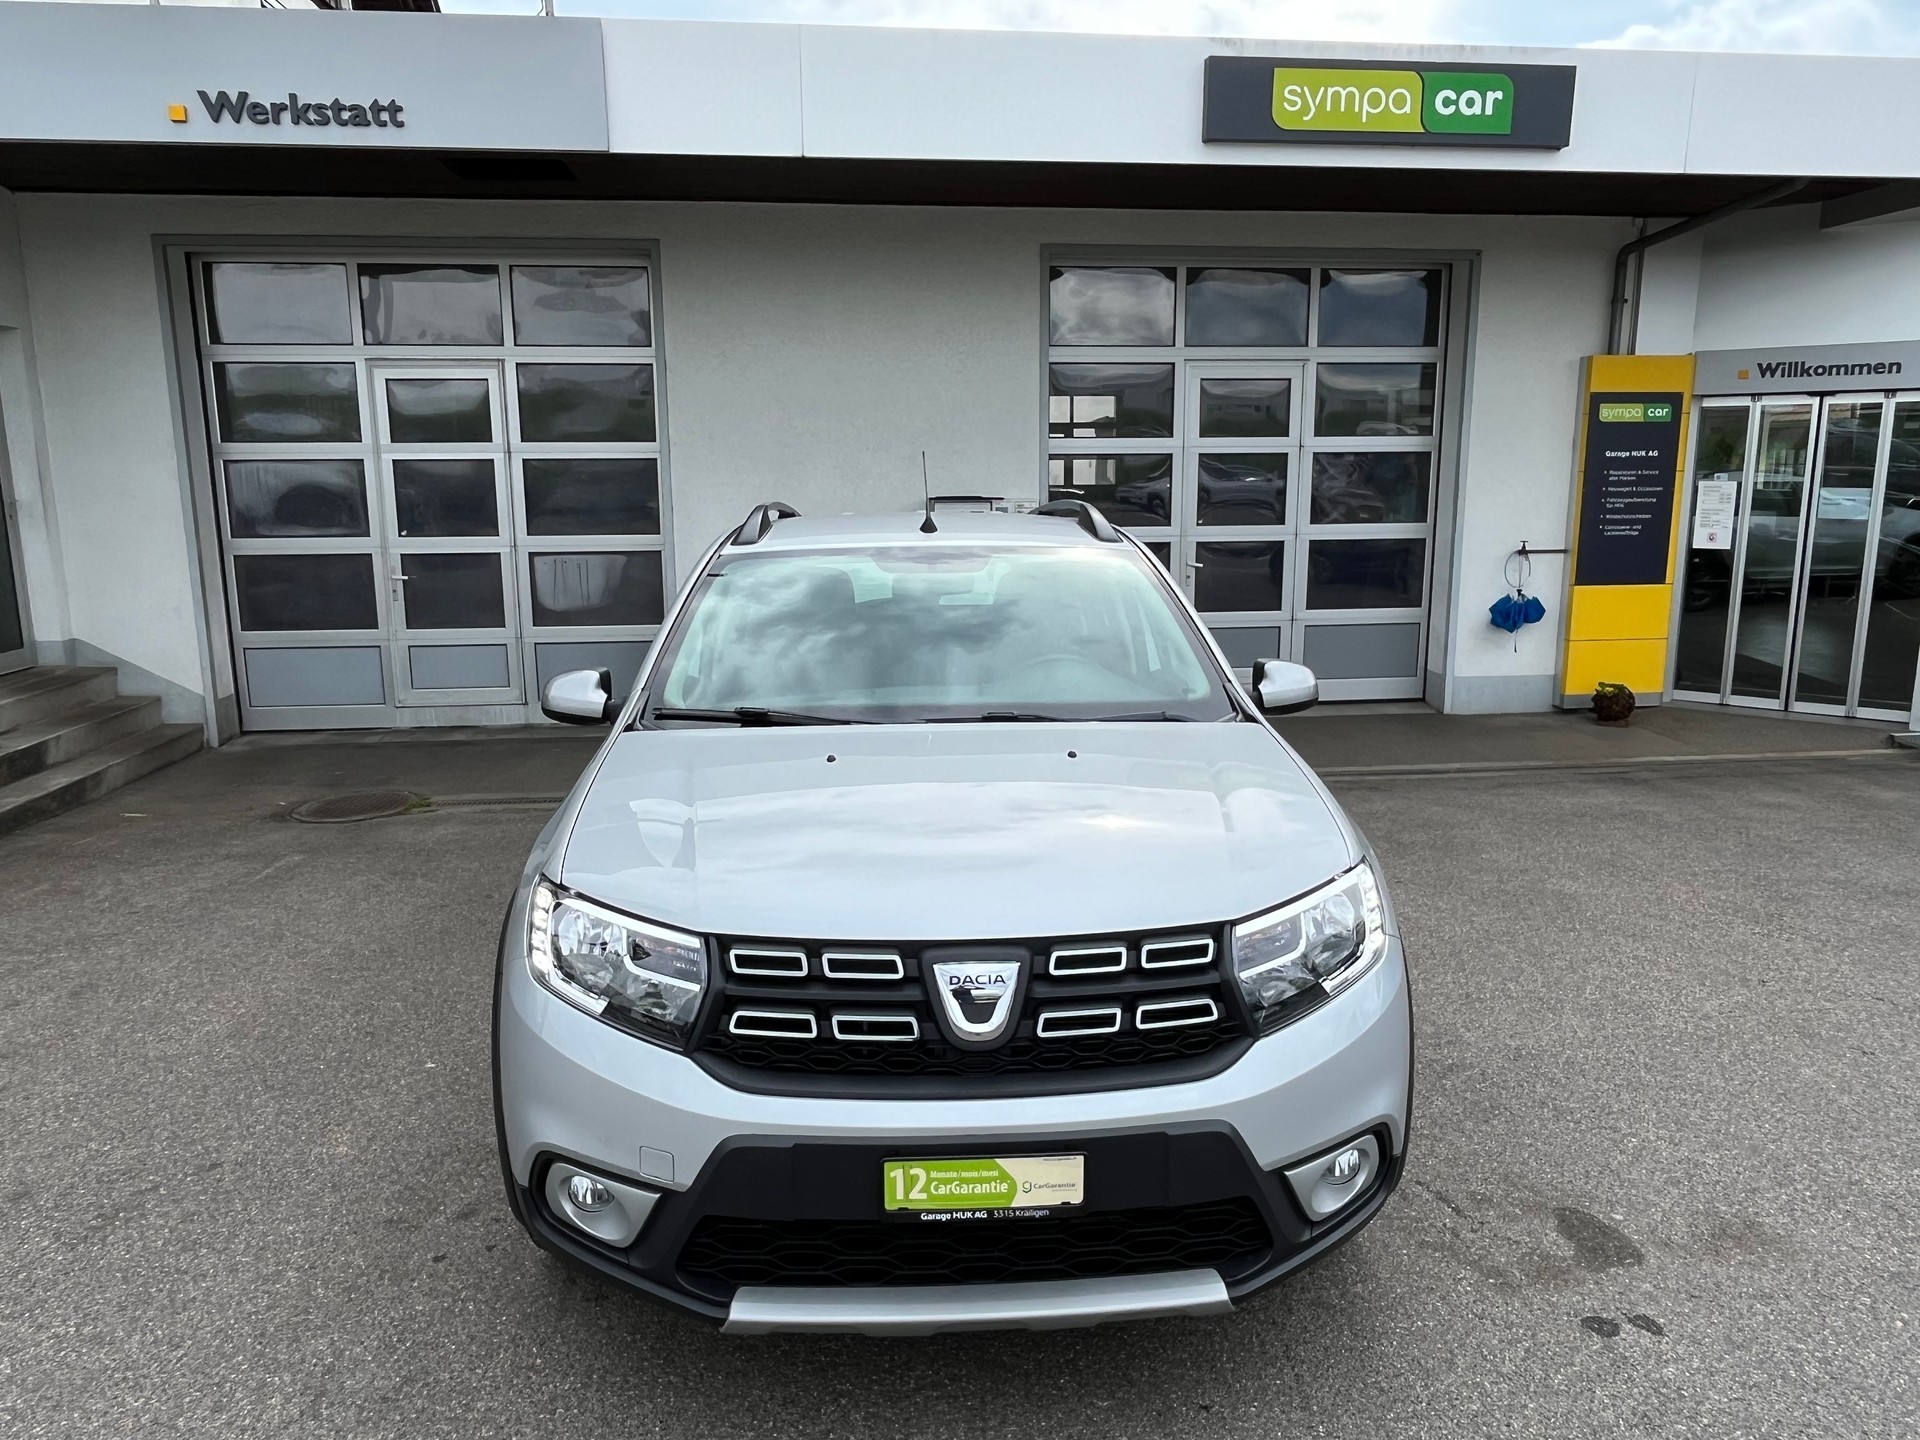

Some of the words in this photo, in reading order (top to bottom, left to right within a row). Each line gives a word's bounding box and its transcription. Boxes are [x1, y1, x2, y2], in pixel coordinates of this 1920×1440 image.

[196, 89, 405, 128] Werkstatt
[1282, 84, 1411, 122] sympa
[1434, 89, 1503, 116] car
[1757, 361, 1902, 379] Willkommen
[1602, 407, 1641, 419] sympa
[1648, 406, 1669, 417] car
[1605, 450, 1630, 458] Garage
[949, 974, 1006, 986] DACIA
[889, 1167, 928, 1200] 12
[930, 1180, 1009, 1195] CarGarantie
[921, 1212, 951, 1221] Garage
[952, 1211, 974, 1219] HUK
[974, 1210, 988, 1218] AG
